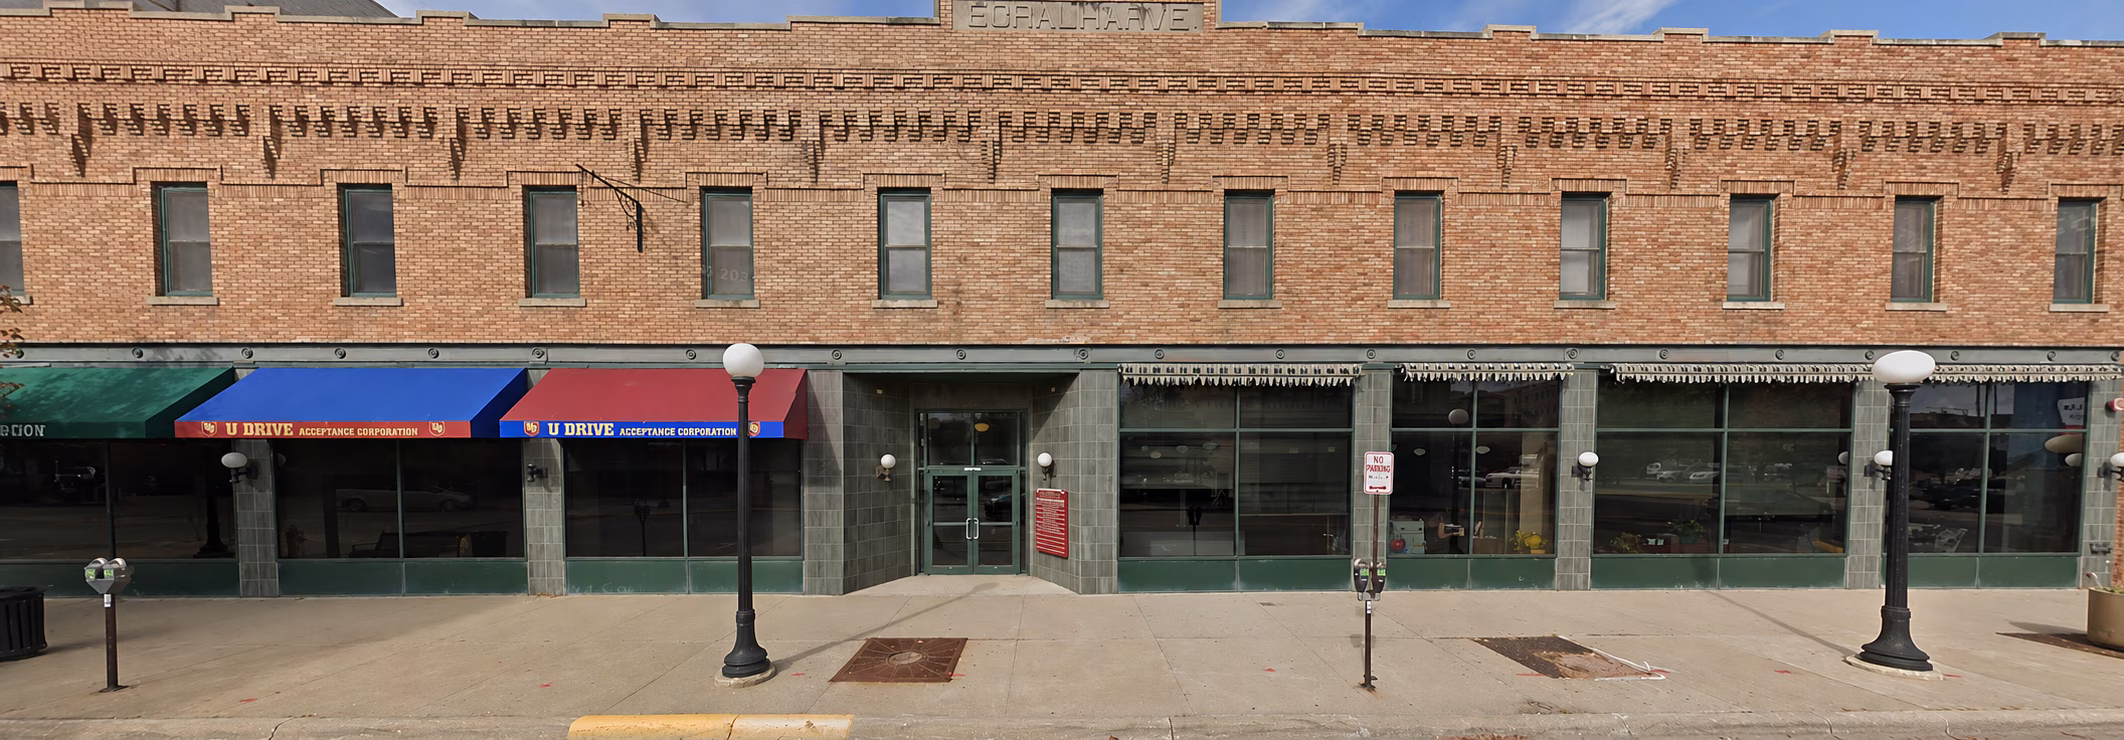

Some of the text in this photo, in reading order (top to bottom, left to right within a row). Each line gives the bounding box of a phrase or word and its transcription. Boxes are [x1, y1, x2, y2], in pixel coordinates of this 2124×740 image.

[225, 422, 418, 436] U DRIVE ACCEPTANCE CORPORATION
[547, 422, 560, 436] U
[564, 422, 615, 436] DRIVE
[619, 427, 676, 436] ACCEPTANCE
[677, 427, 737, 436] CORPORATION
[1373, 455, 1384, 464] NO
